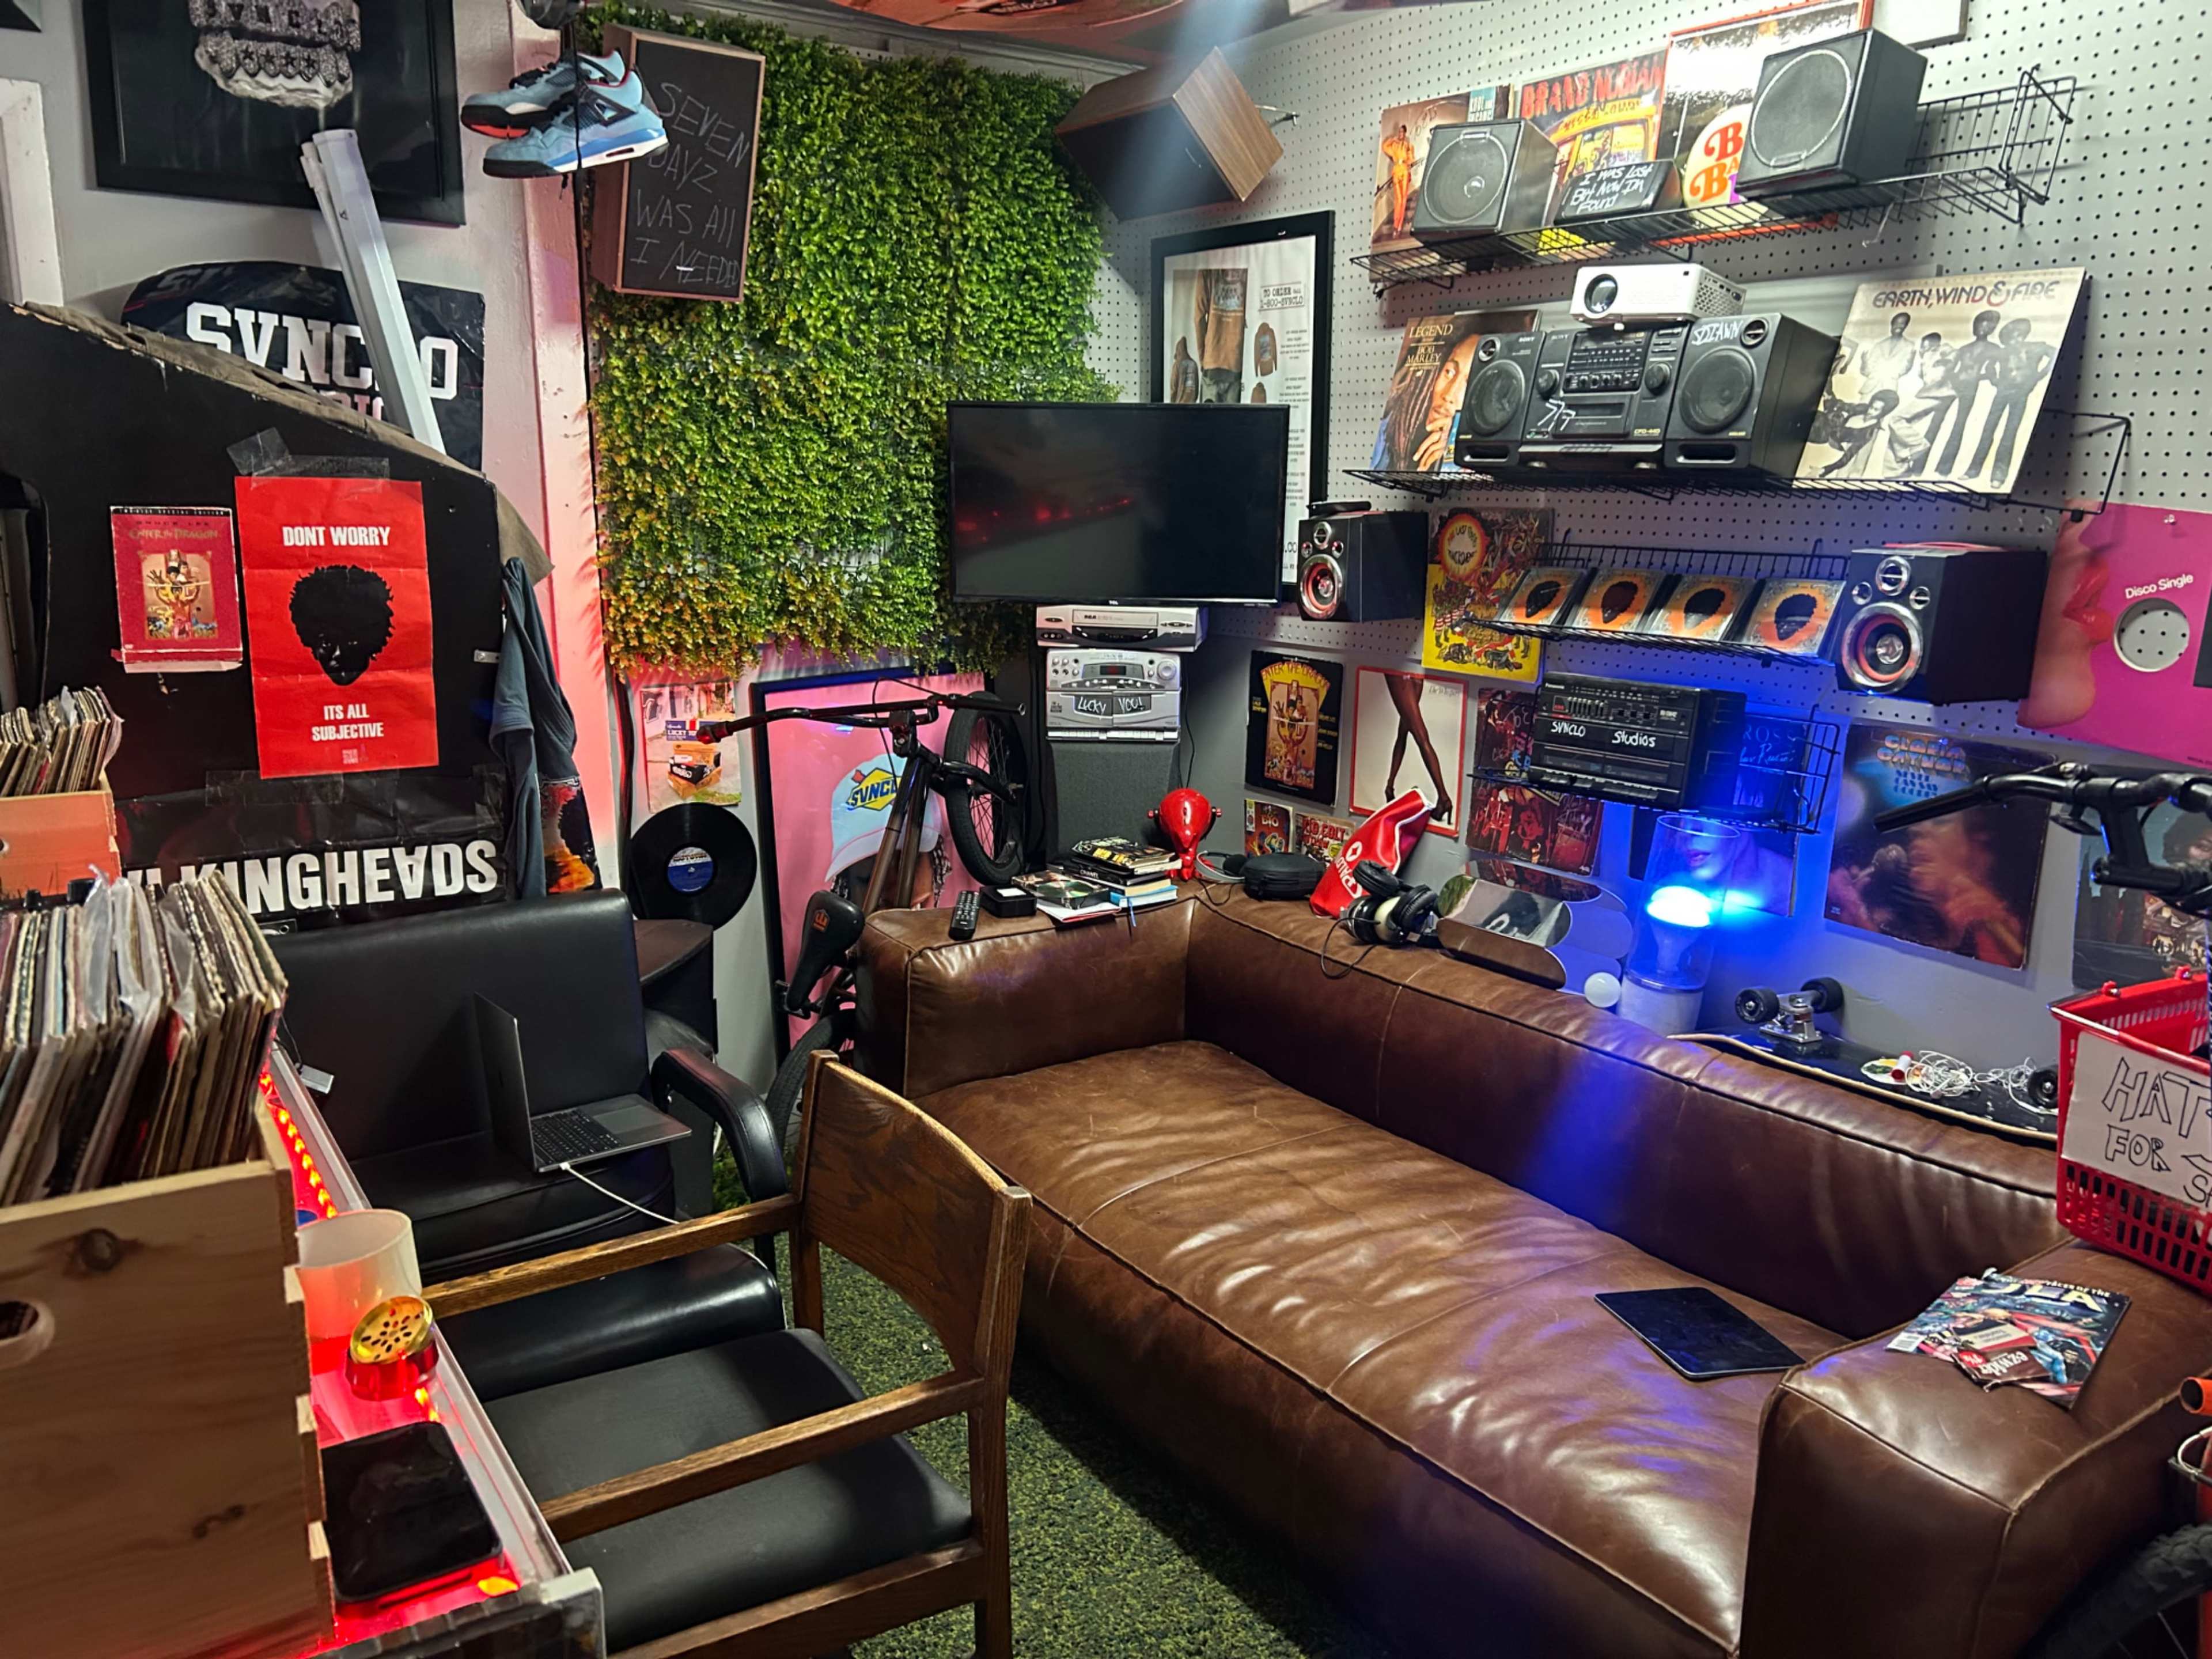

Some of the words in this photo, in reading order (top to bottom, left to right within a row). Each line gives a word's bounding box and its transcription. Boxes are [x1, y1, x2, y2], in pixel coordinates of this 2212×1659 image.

[1521, 73, 1589, 120] BRAND
[658, 82, 749, 168] SEVEN
[637, 188, 692, 234] WAS
[630, 236, 660, 264] I
[1409, 323, 1453, 338] LEGEND
[186, 301, 459, 401] SVNCO
[1407, 353, 1441, 363] MARLEY
[282, 527, 325, 546] DONT
[329, 527, 391, 546] WORRY
[2125, 584, 2157, 599] Disco
[2158, 574, 2194, 590] Single
[324, 704, 344, 721] ITS
[347, 703, 370, 719] ALL
[312, 722, 385, 742] SUBJECTIVE
[847, 779, 897, 807] SVNCL
[2102, 1056, 2212, 1139] HAT
[2105, 1124, 2172, 1172] FOR
